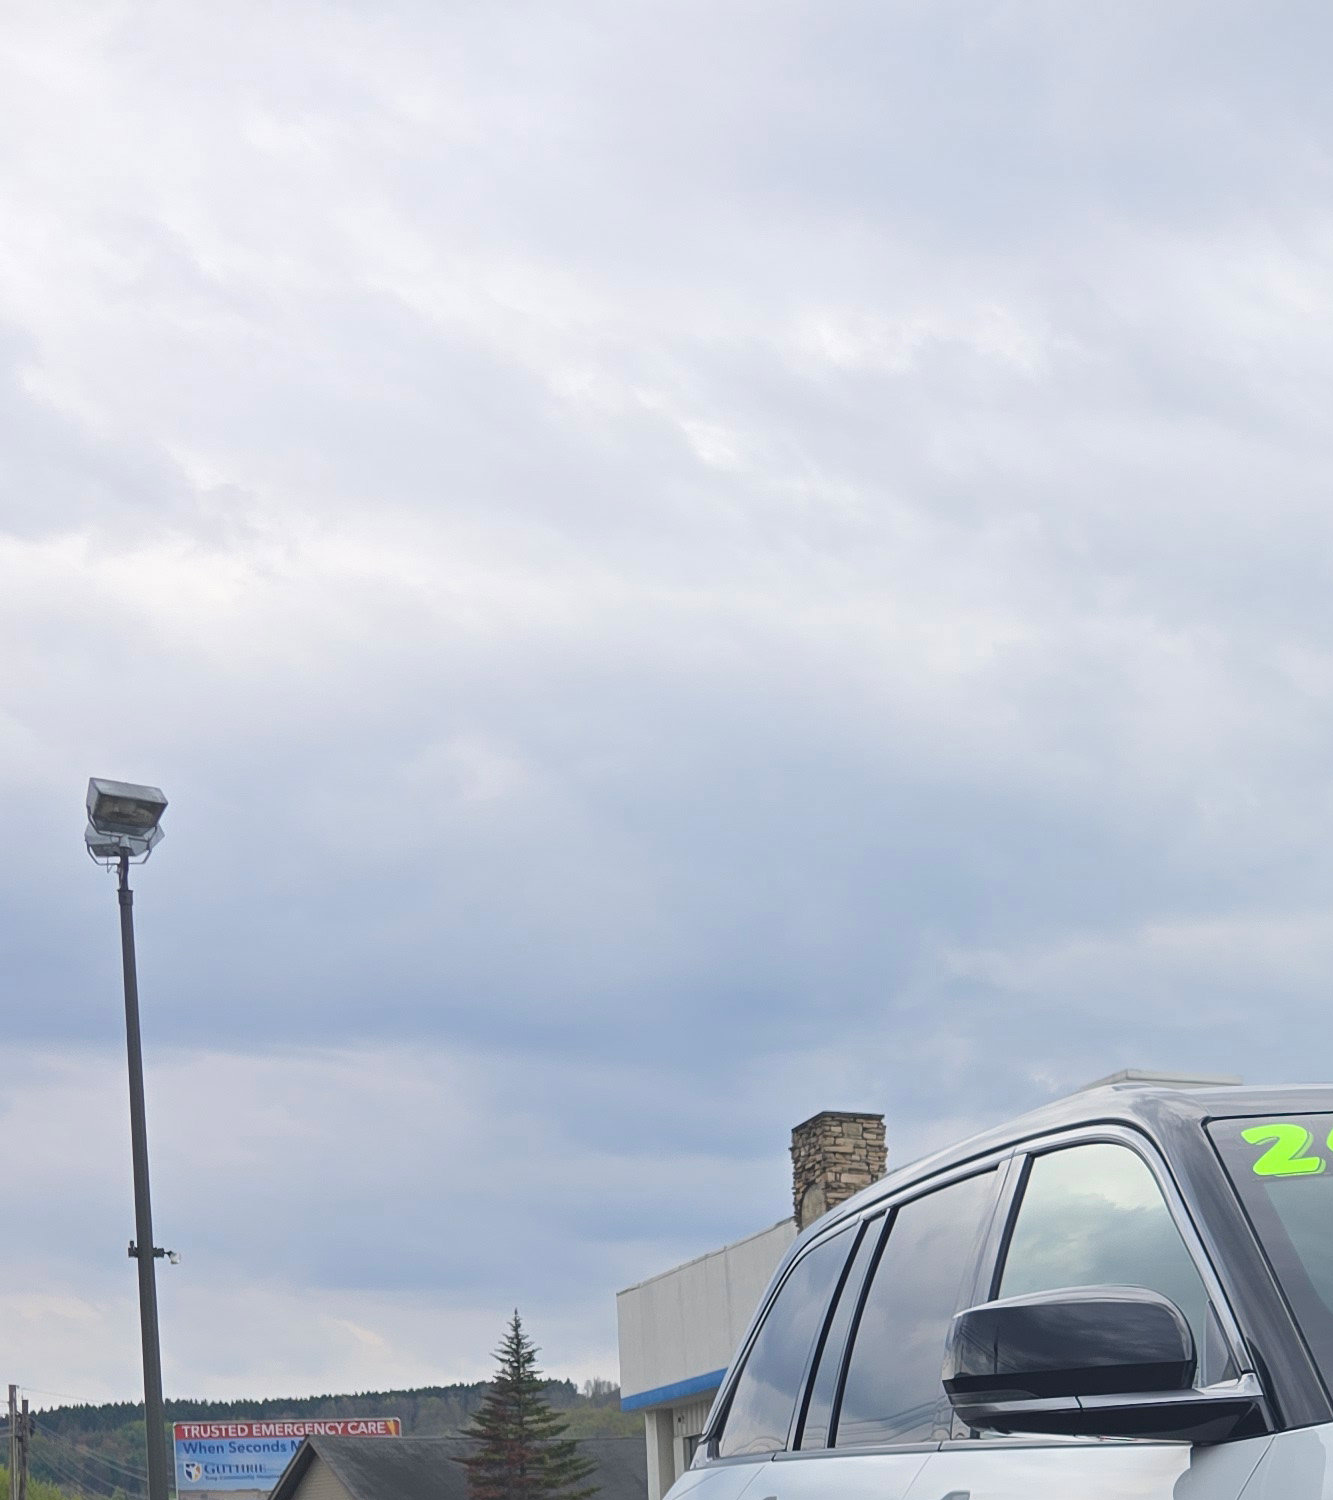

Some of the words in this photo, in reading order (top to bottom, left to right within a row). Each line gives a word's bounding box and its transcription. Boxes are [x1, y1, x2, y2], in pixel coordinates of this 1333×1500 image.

[182, 1425, 249, 1438] TRUSTED
[252, 1422, 344, 1437] EMERGENCY
[347, 1421, 386, 1434] CARE
[183, 1441, 225, 1454] When
[228, 1440, 287, 1453] Seconds
